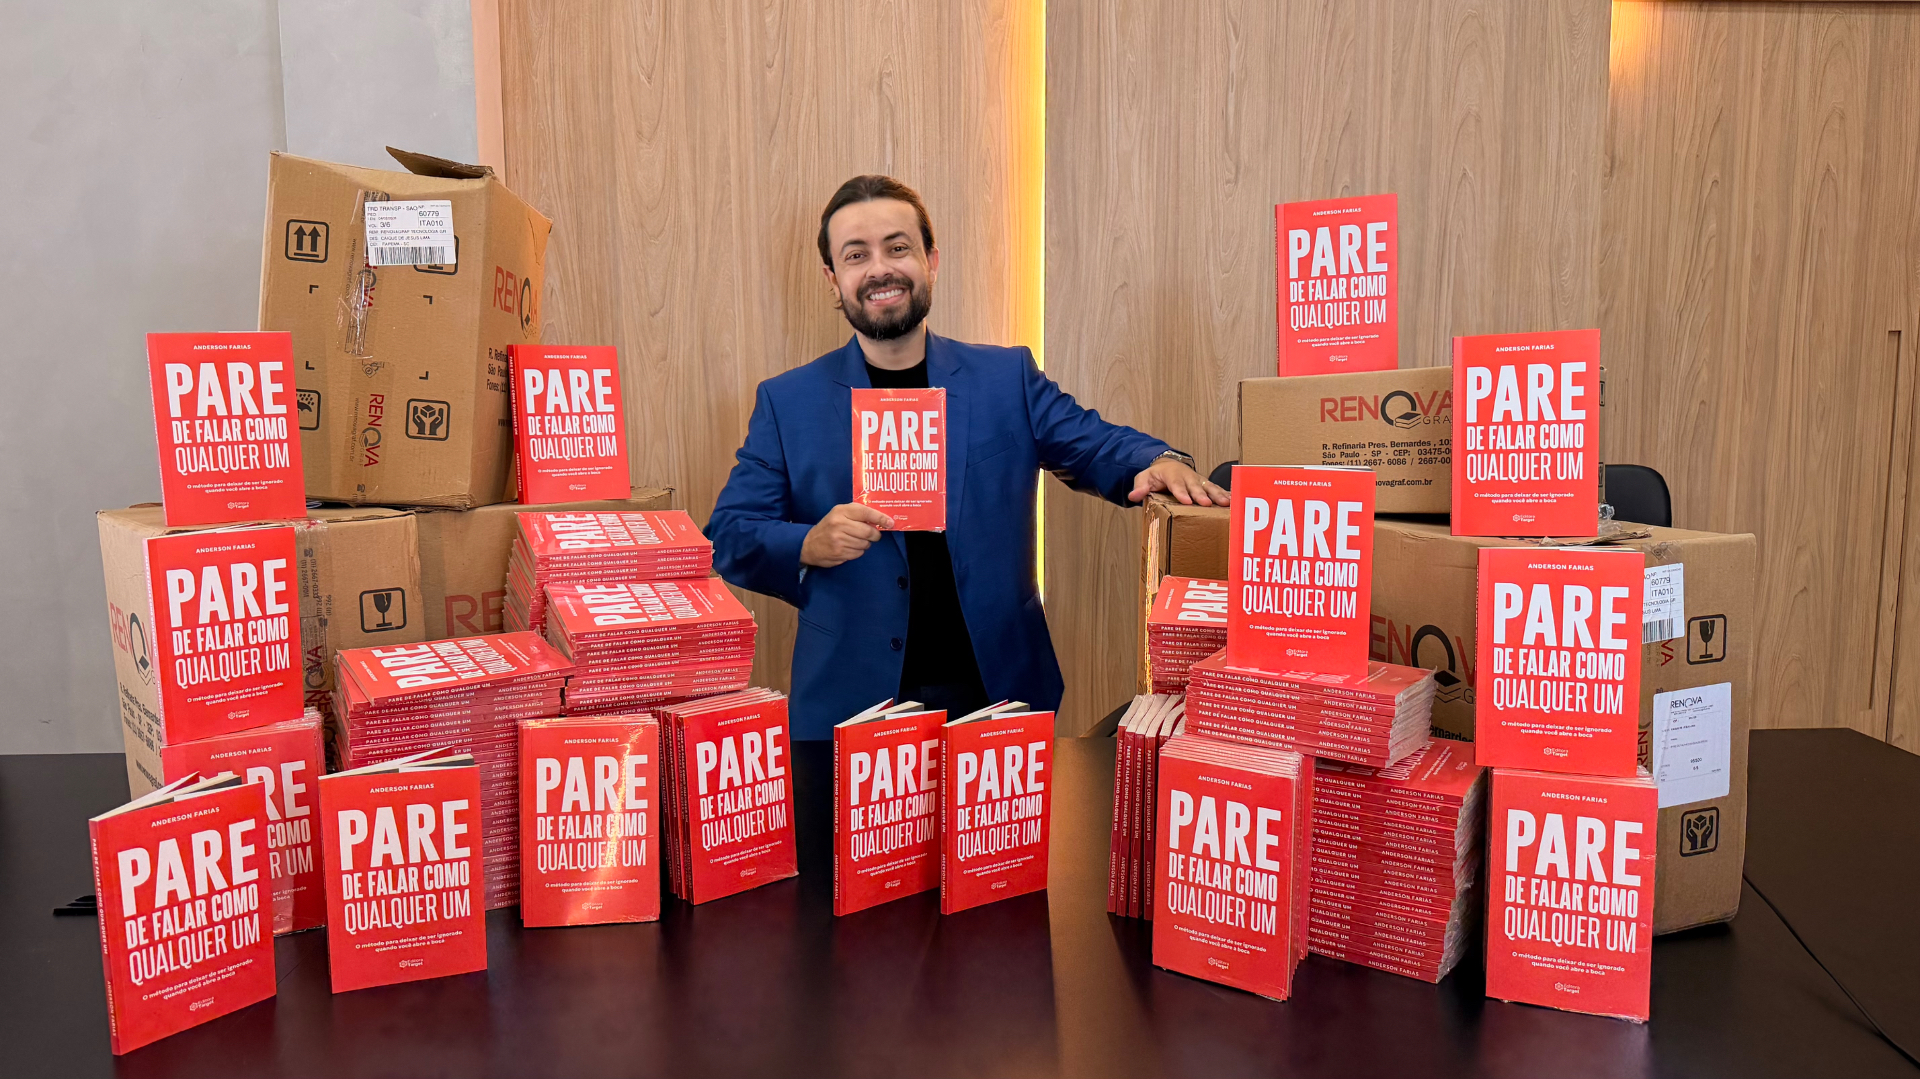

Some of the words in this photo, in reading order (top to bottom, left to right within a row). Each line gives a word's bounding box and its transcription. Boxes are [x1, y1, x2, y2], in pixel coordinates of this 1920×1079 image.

[1289, 222, 1387, 279] PARE
[1290, 281, 1304, 302] DE
[1309, 278, 1346, 301] FALAR
[1351, 274, 1386, 298] COMO
[1291, 301, 1360, 331] QUALQUER
[1365, 299, 1386, 322] UM
[165, 362, 287, 418] PARE
[523, 369, 614, 414] PARE
[1466, 362, 1586, 423] PARE
[172, 421, 191, 444] DE
[195, 419, 242, 443] FALAR
[245, 417, 288, 440] COMO
[861, 411, 938, 450] PARE
[1423, 415, 1451, 425] GRA
[1467, 426, 1484, 450] DE
[1489, 425, 1535, 450] FALAR
[1540, 423, 1584, 448] COMO
[175, 444, 260, 475] QUALQUER
[264, 442, 290, 467] UM
[862, 453, 874, 470] DE
[877, 453, 907, 470] FALAR
[910, 453, 938, 469] COMO
[1467, 453, 1550, 483] QUALQUER
[1557, 452, 1583, 479] UM
[863, 473, 917, 493] QUALQUER
[921, 472, 937, 490] UM
[1243, 498, 1362, 559] PARE
[167, 559, 288, 628] PARE
[1651, 577, 1670, 585] 60779
[1652, 588, 1673, 596] ITA010
[1494, 582, 1629, 650] PARE
[1369, 614, 1476, 688] ENOV
[1493, 648, 1513, 674] DE
[1518, 649, 1570, 678] FALAR
[1576, 652, 1625, 680] COMO
[1260, 679, 1289, 687] QUALQUER
[1324, 688, 1354, 696] ANDERSON
[1494, 678, 1587, 713] QUALQUER
[1594, 684, 1623, 714] UM
[696, 726, 785, 796] PARE
[851, 738, 937, 806] PARE
[957, 741, 1045, 806] PARE
[1198, 775, 1229, 786] ANDERSON
[1231, 782, 1252, 790] FARIAS
[536, 754, 648, 814] PARE
[700, 796, 714, 821] DE
[717, 786, 752, 816] FALAR
[755, 778, 785, 807] COMO
[152, 813, 192, 827] ANDERSON
[194, 807, 219, 817] FARIAS
[702, 809, 765, 851] QUALQUER
[768, 803, 786, 830] UM
[957, 808, 971, 831] DE
[975, 800, 1009, 828] FALAR
[1012, 794, 1042, 820] COMO
[1169, 789, 1281, 872] PARE
[338, 799, 470, 871] PARE
[958, 823, 1019, 861] QUALQUER
[1023, 818, 1041, 844] UM
[1506, 809, 1642, 886] PARE
[117, 818, 258, 918] PARE
[342, 873, 363, 900] DE
[368, 866, 419, 897] FALAR
[424, 861, 469, 890] COMO
[1168, 852, 1184, 880] DE
[1189, 856, 1232, 892] FALAR
[1236, 867, 1277, 902] COMO
[125, 916, 148, 949] DE
[152, 898, 207, 941] FALAR
[211, 883, 258, 922] COMO
[344, 894, 437, 934] QUALQUER
[443, 889, 470, 918] UM
[1168, 882, 1245, 928] QUALQUER
[1250, 902, 1275, 936] UM
[1505, 875, 1525, 904] DE
[1530, 878, 1583, 911] FALAR
[1588, 885, 1638, 918] COMO
[128, 924, 227, 984] QUALQUER
[232, 913, 260, 948] UM
[1504, 906, 1600, 949] QUALQUER
[1606, 920, 1636, 953] UM
